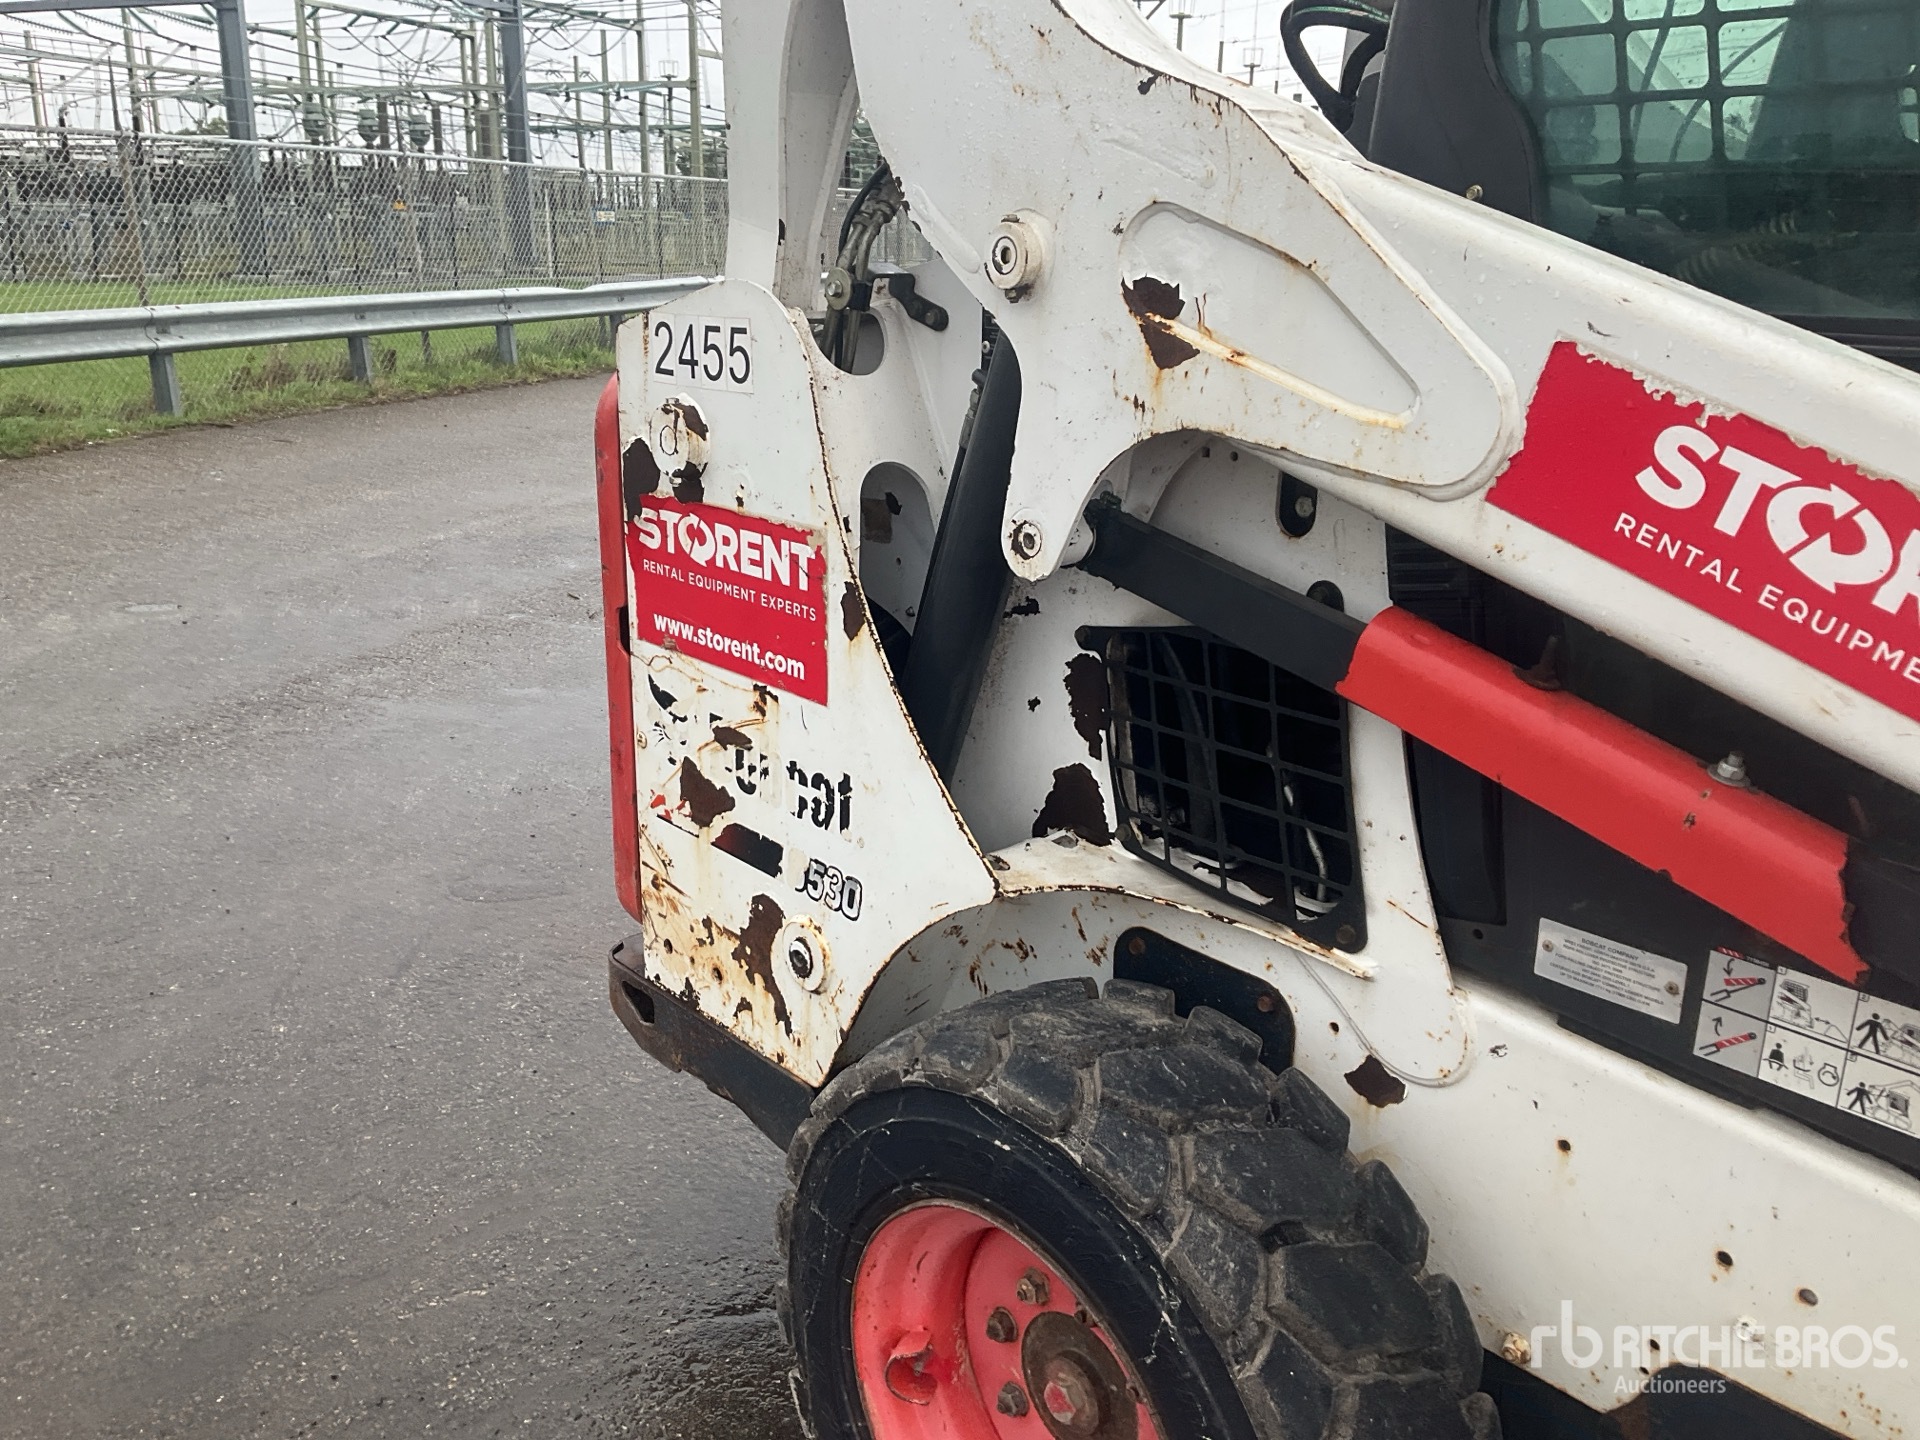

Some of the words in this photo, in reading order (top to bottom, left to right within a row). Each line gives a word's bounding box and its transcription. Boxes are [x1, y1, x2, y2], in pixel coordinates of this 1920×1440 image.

[654, 320, 751, 385] 2455
[638, 506, 816, 592] STORENT
[1613, 512, 1744, 593] RENTAL
[643, 559, 685, 582] RENTAL
[688, 571, 756, 603] EQUIPMENT
[761, 593, 817, 622] EXPERTS
[654, 613, 805, 681] www.storent.com
[794, 857, 863, 921] 530
